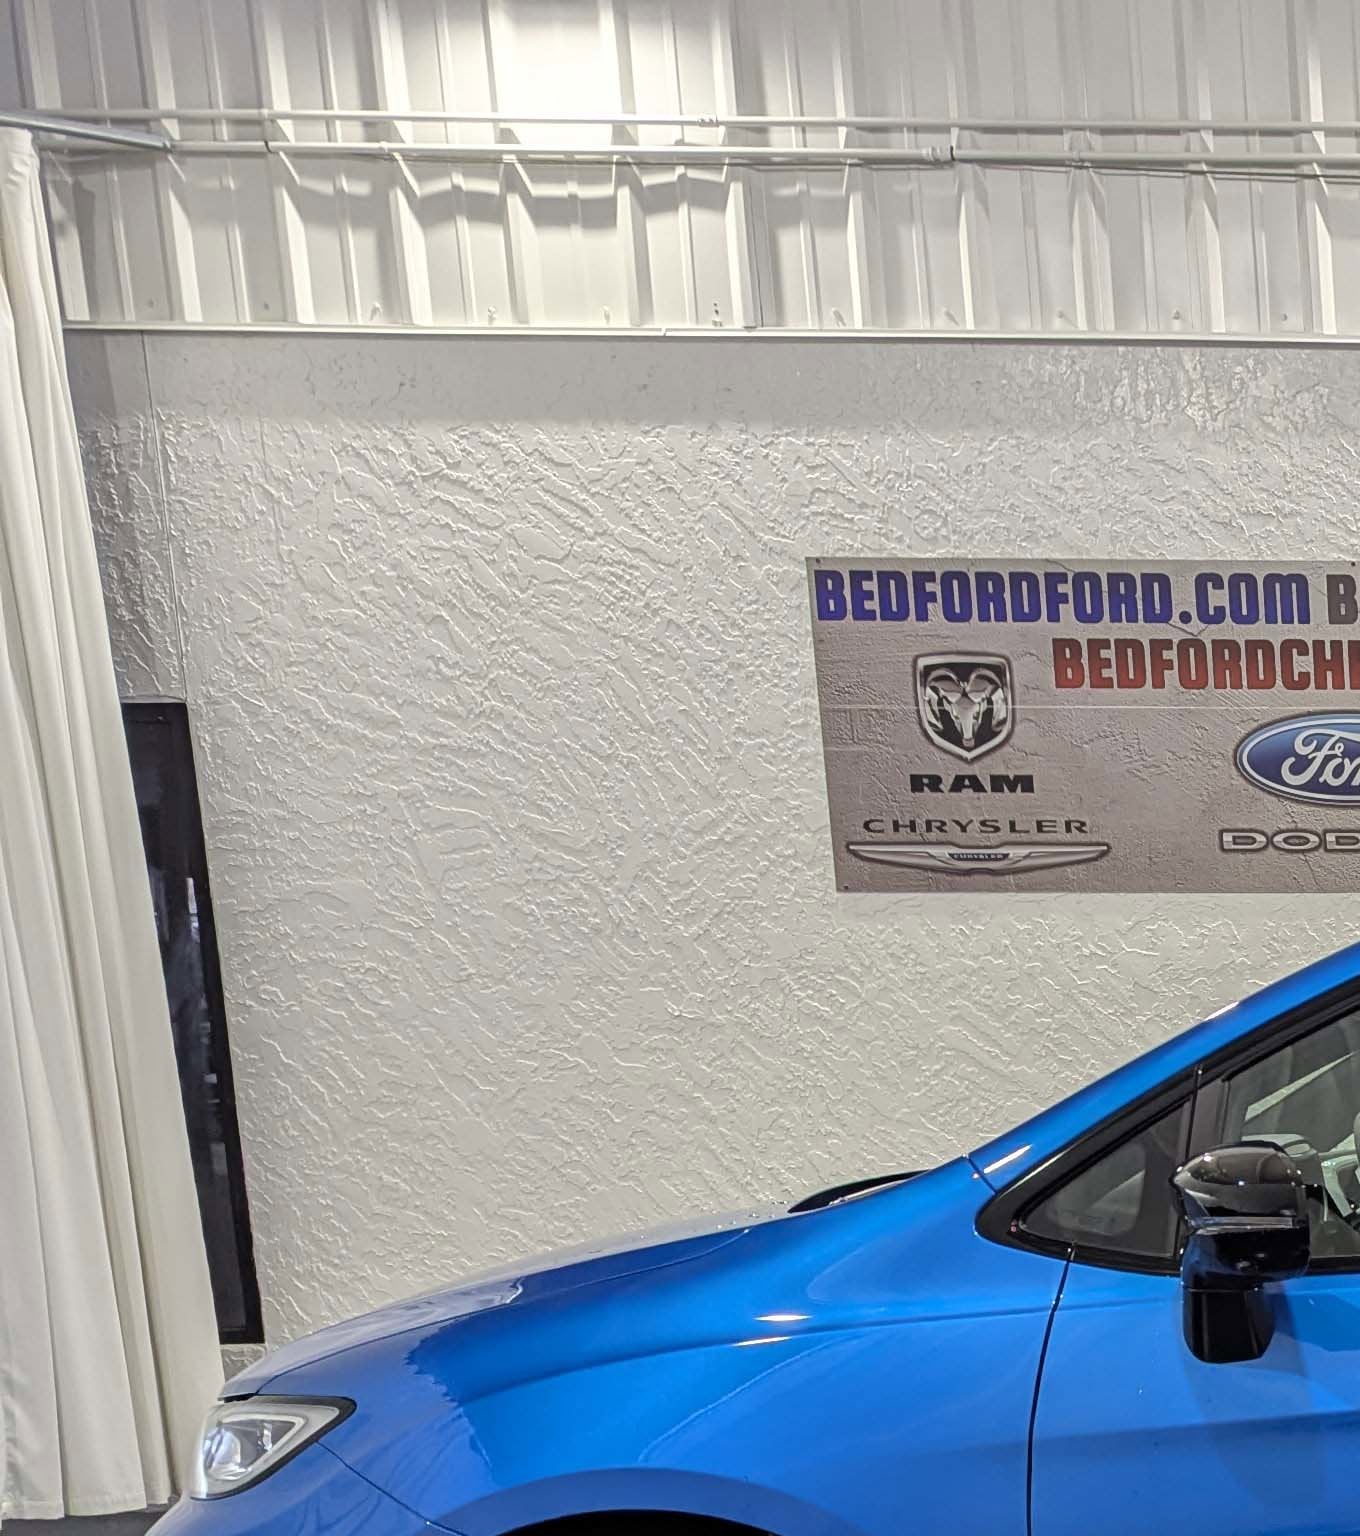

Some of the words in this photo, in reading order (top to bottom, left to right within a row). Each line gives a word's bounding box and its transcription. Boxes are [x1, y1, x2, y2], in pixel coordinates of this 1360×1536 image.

[814, 570, 1311, 625] BEDFORDFORD.COM
[909, 774, 1035, 795] RAM
[862, 818, 1090, 835] CHRYSLER
